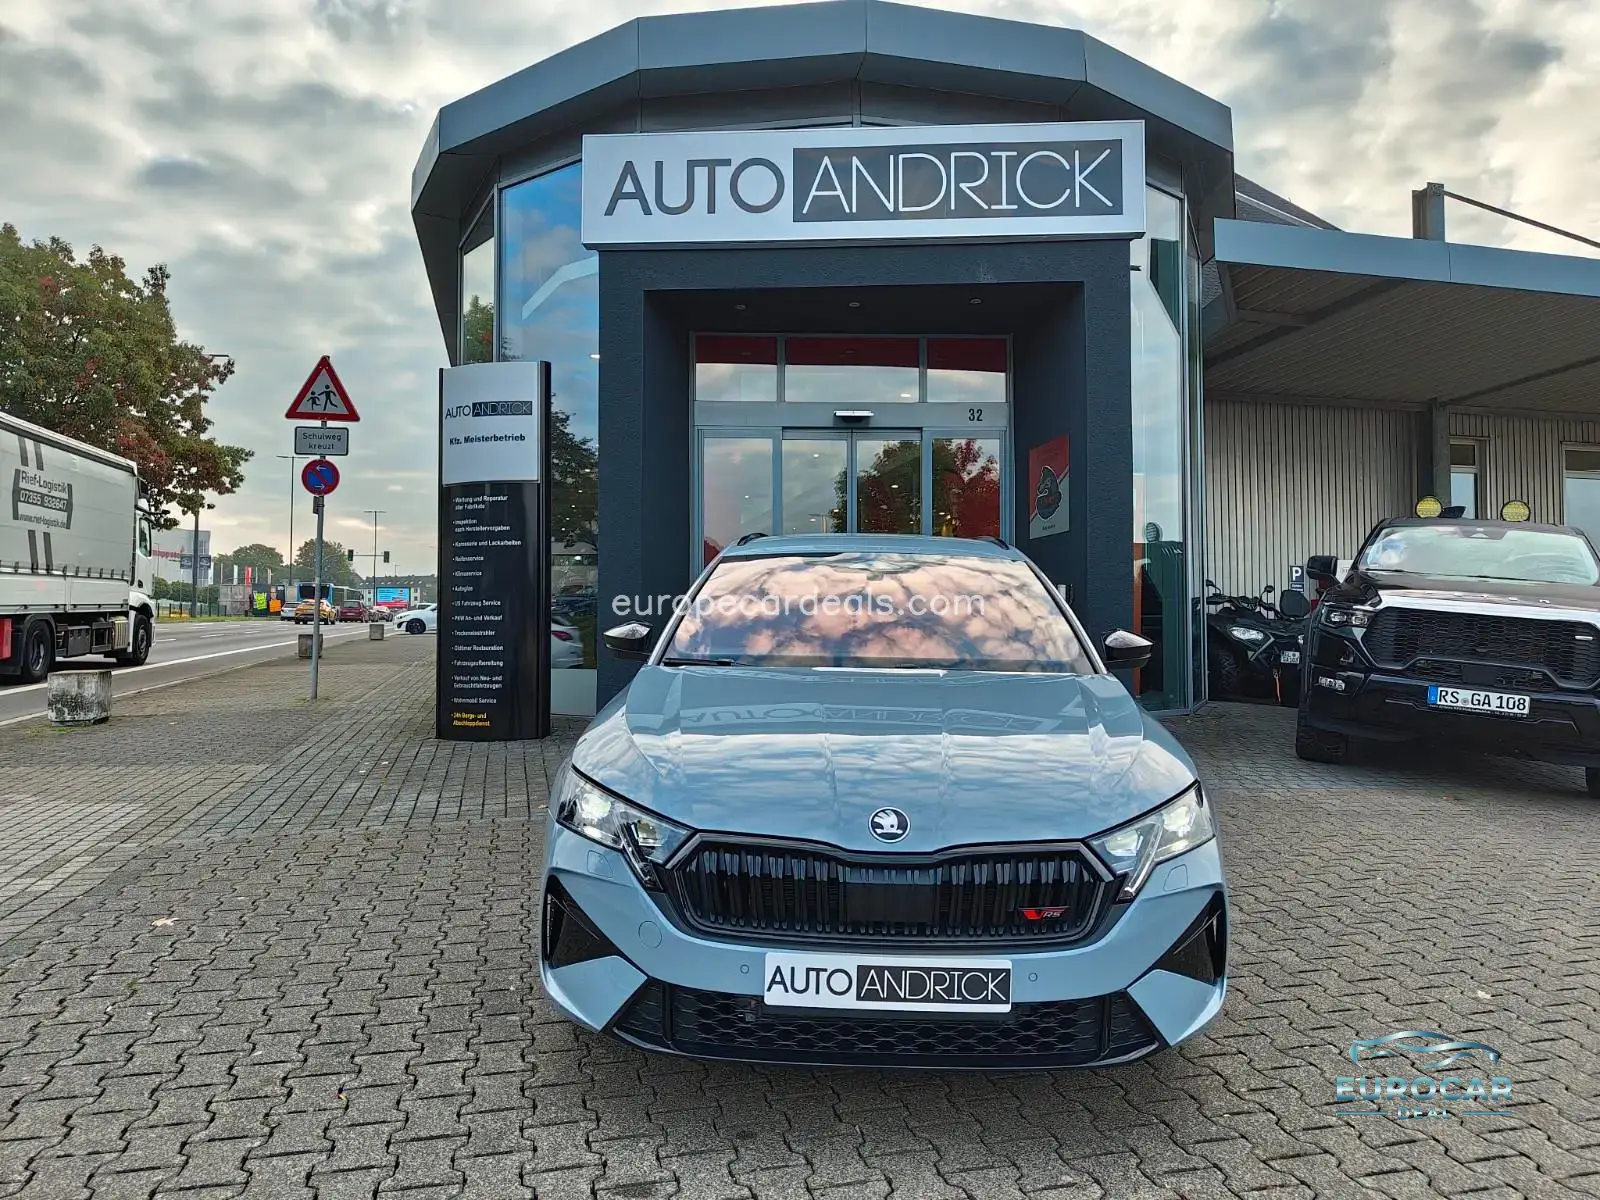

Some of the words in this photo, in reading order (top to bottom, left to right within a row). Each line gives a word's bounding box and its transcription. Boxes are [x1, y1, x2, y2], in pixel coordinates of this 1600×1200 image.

[603, 157, 785, 217] AUTO
[802, 148, 1113, 214] ANDRICK
[445, 405, 471, 420] AUTO
[473, 402, 531, 415] ANDRICK
[968, 408, 983, 421] 32
[302, 432, 342, 441] Schulweg
[449, 437, 462, 445] Kfz.
[464, 433, 526, 443] Meisterbetrieb
[21, 470, 67, 494] Rief-Logistik
[20, 491, 42, 505] 07355
[1292, 566, 1302, 581] P
[1439, 689, 1460, 704] RS
[1470, 692, 1492, 708] GA
[1495, 695, 1527, 711] 108
[766, 964, 853, 996] AUTO
[860, 968, 1007, 1001] ANDRICK
